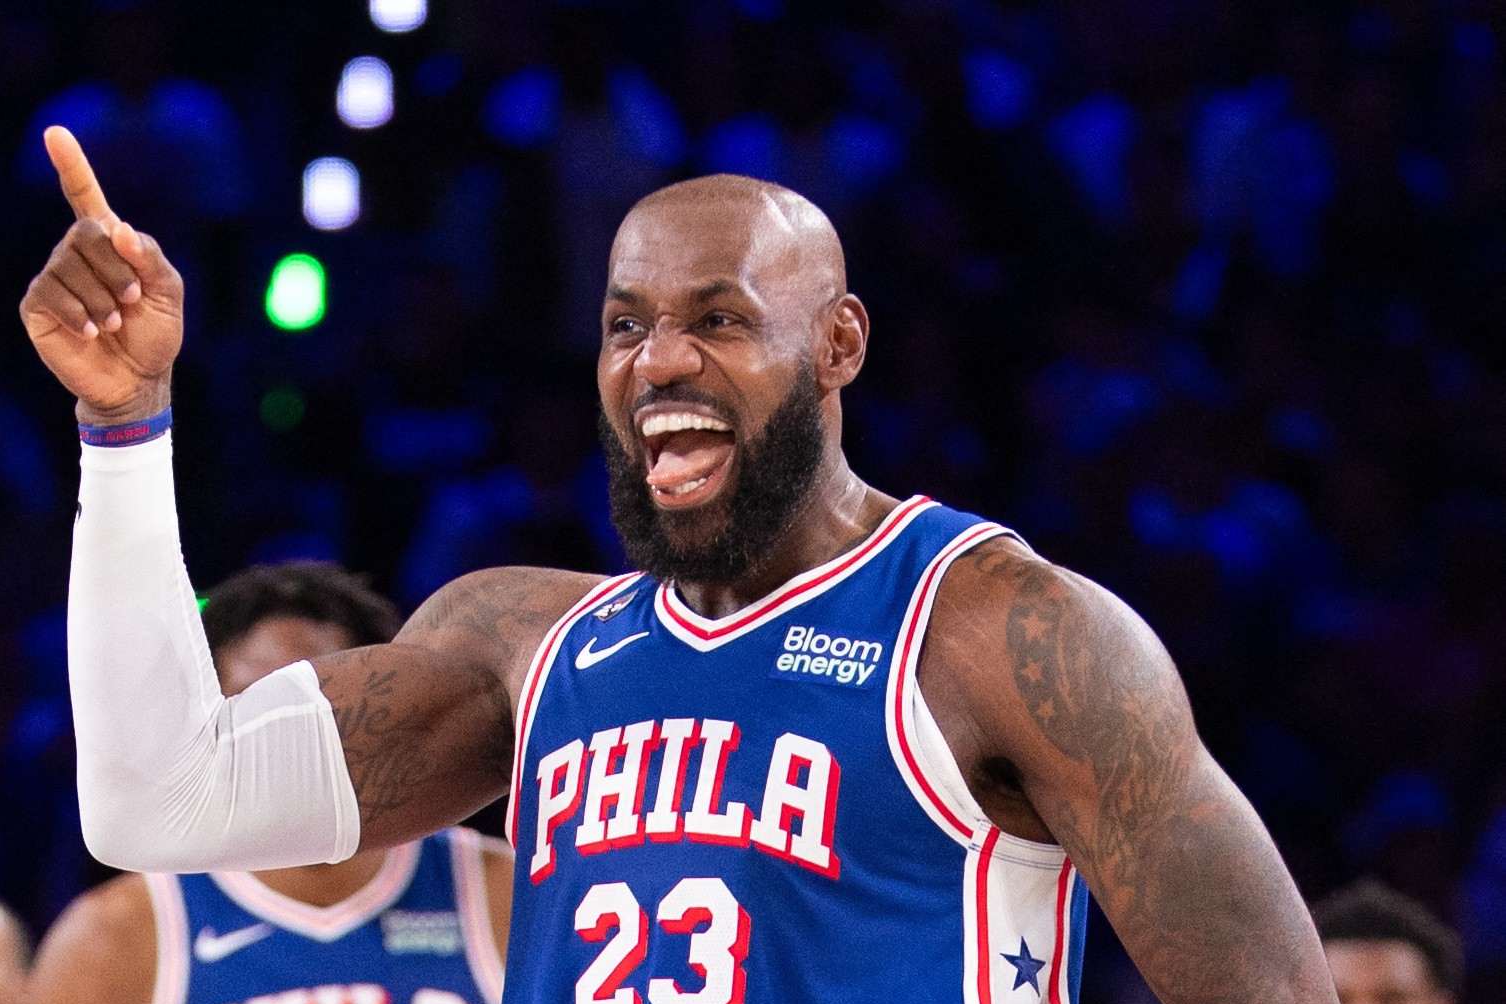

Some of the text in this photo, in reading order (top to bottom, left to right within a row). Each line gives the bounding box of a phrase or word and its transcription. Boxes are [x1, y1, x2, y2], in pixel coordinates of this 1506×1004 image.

[783, 625, 883, 662] Bloom
[776, 653, 877, 686] energy
[530, 717, 841, 885] PHILA
